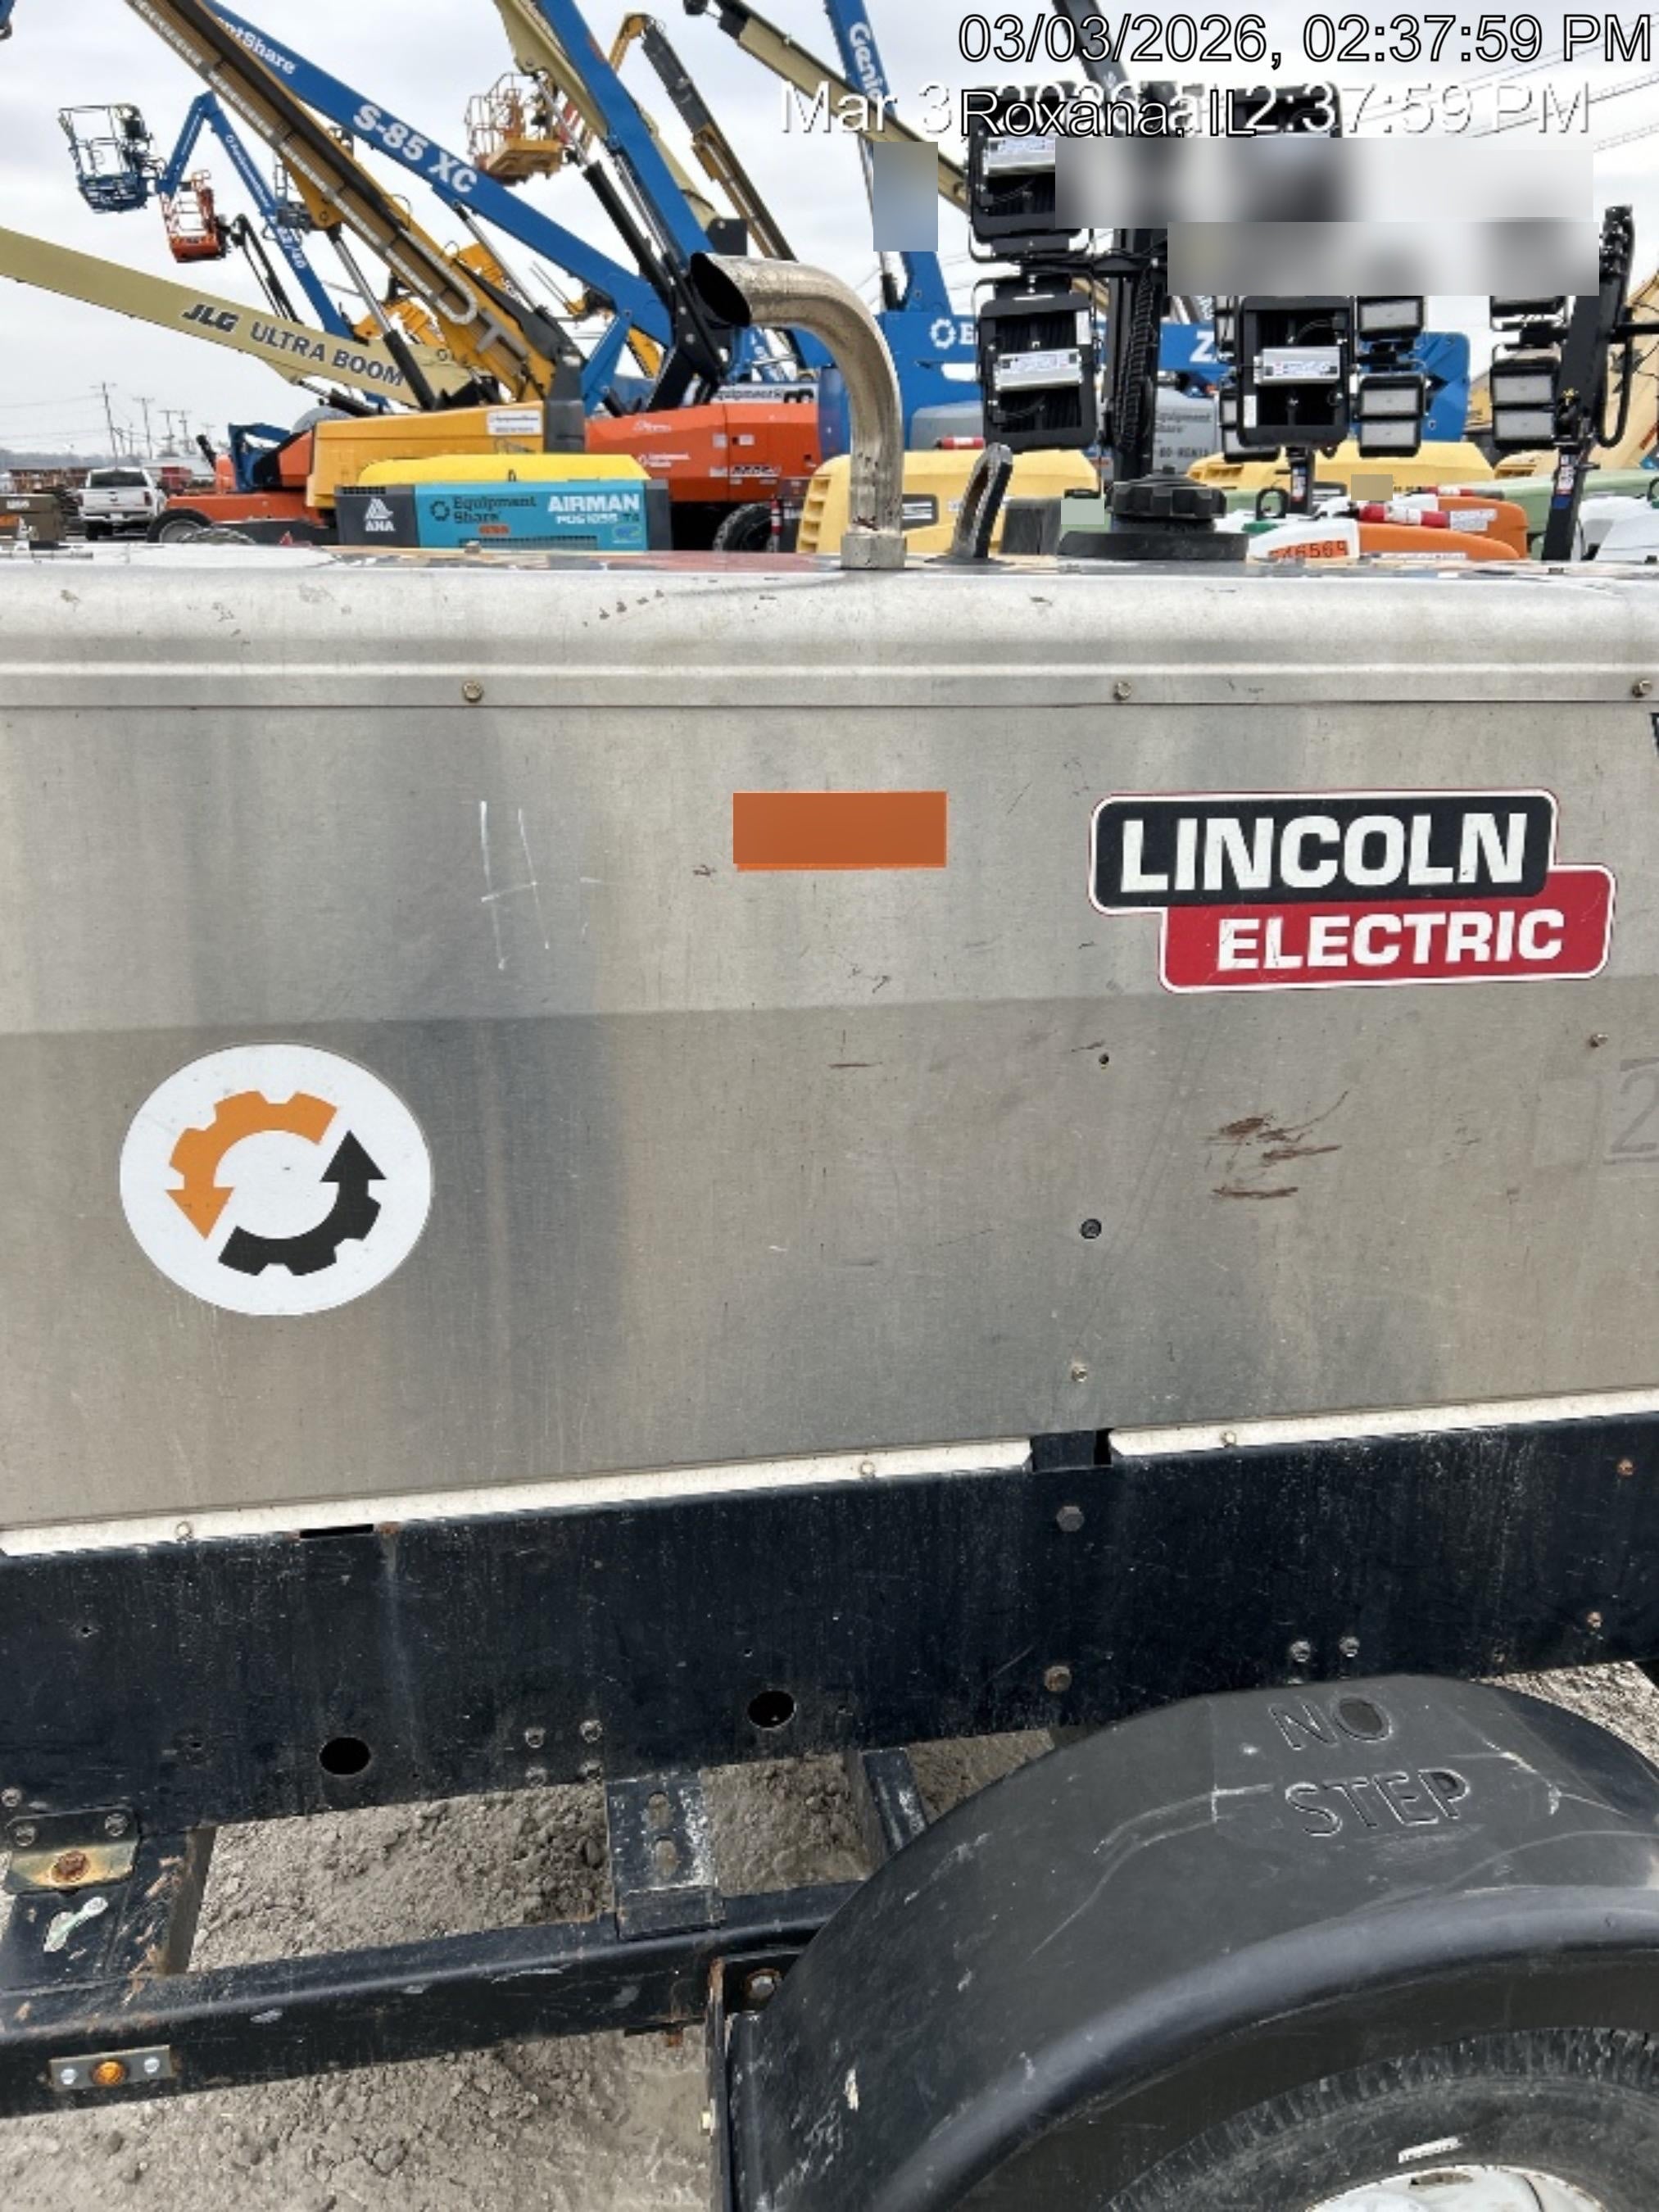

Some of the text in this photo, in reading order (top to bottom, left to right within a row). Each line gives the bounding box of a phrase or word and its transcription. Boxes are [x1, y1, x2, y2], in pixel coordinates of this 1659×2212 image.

[352, 104, 478, 193] S-85 XC
[181, 303, 239, 333] JLG
[250, 320, 405, 387] ULTRA BOOM
[452, 496, 537, 511] Equipment
[547, 493, 640, 512] AIRMAN
[1120, 812, 1528, 893] LINCOLN
[1217, 909, 1566, 972] ELECTRIC
[1267, 1693, 1394, 1751] NO
[1285, 1767, 1472, 1837] STEP
